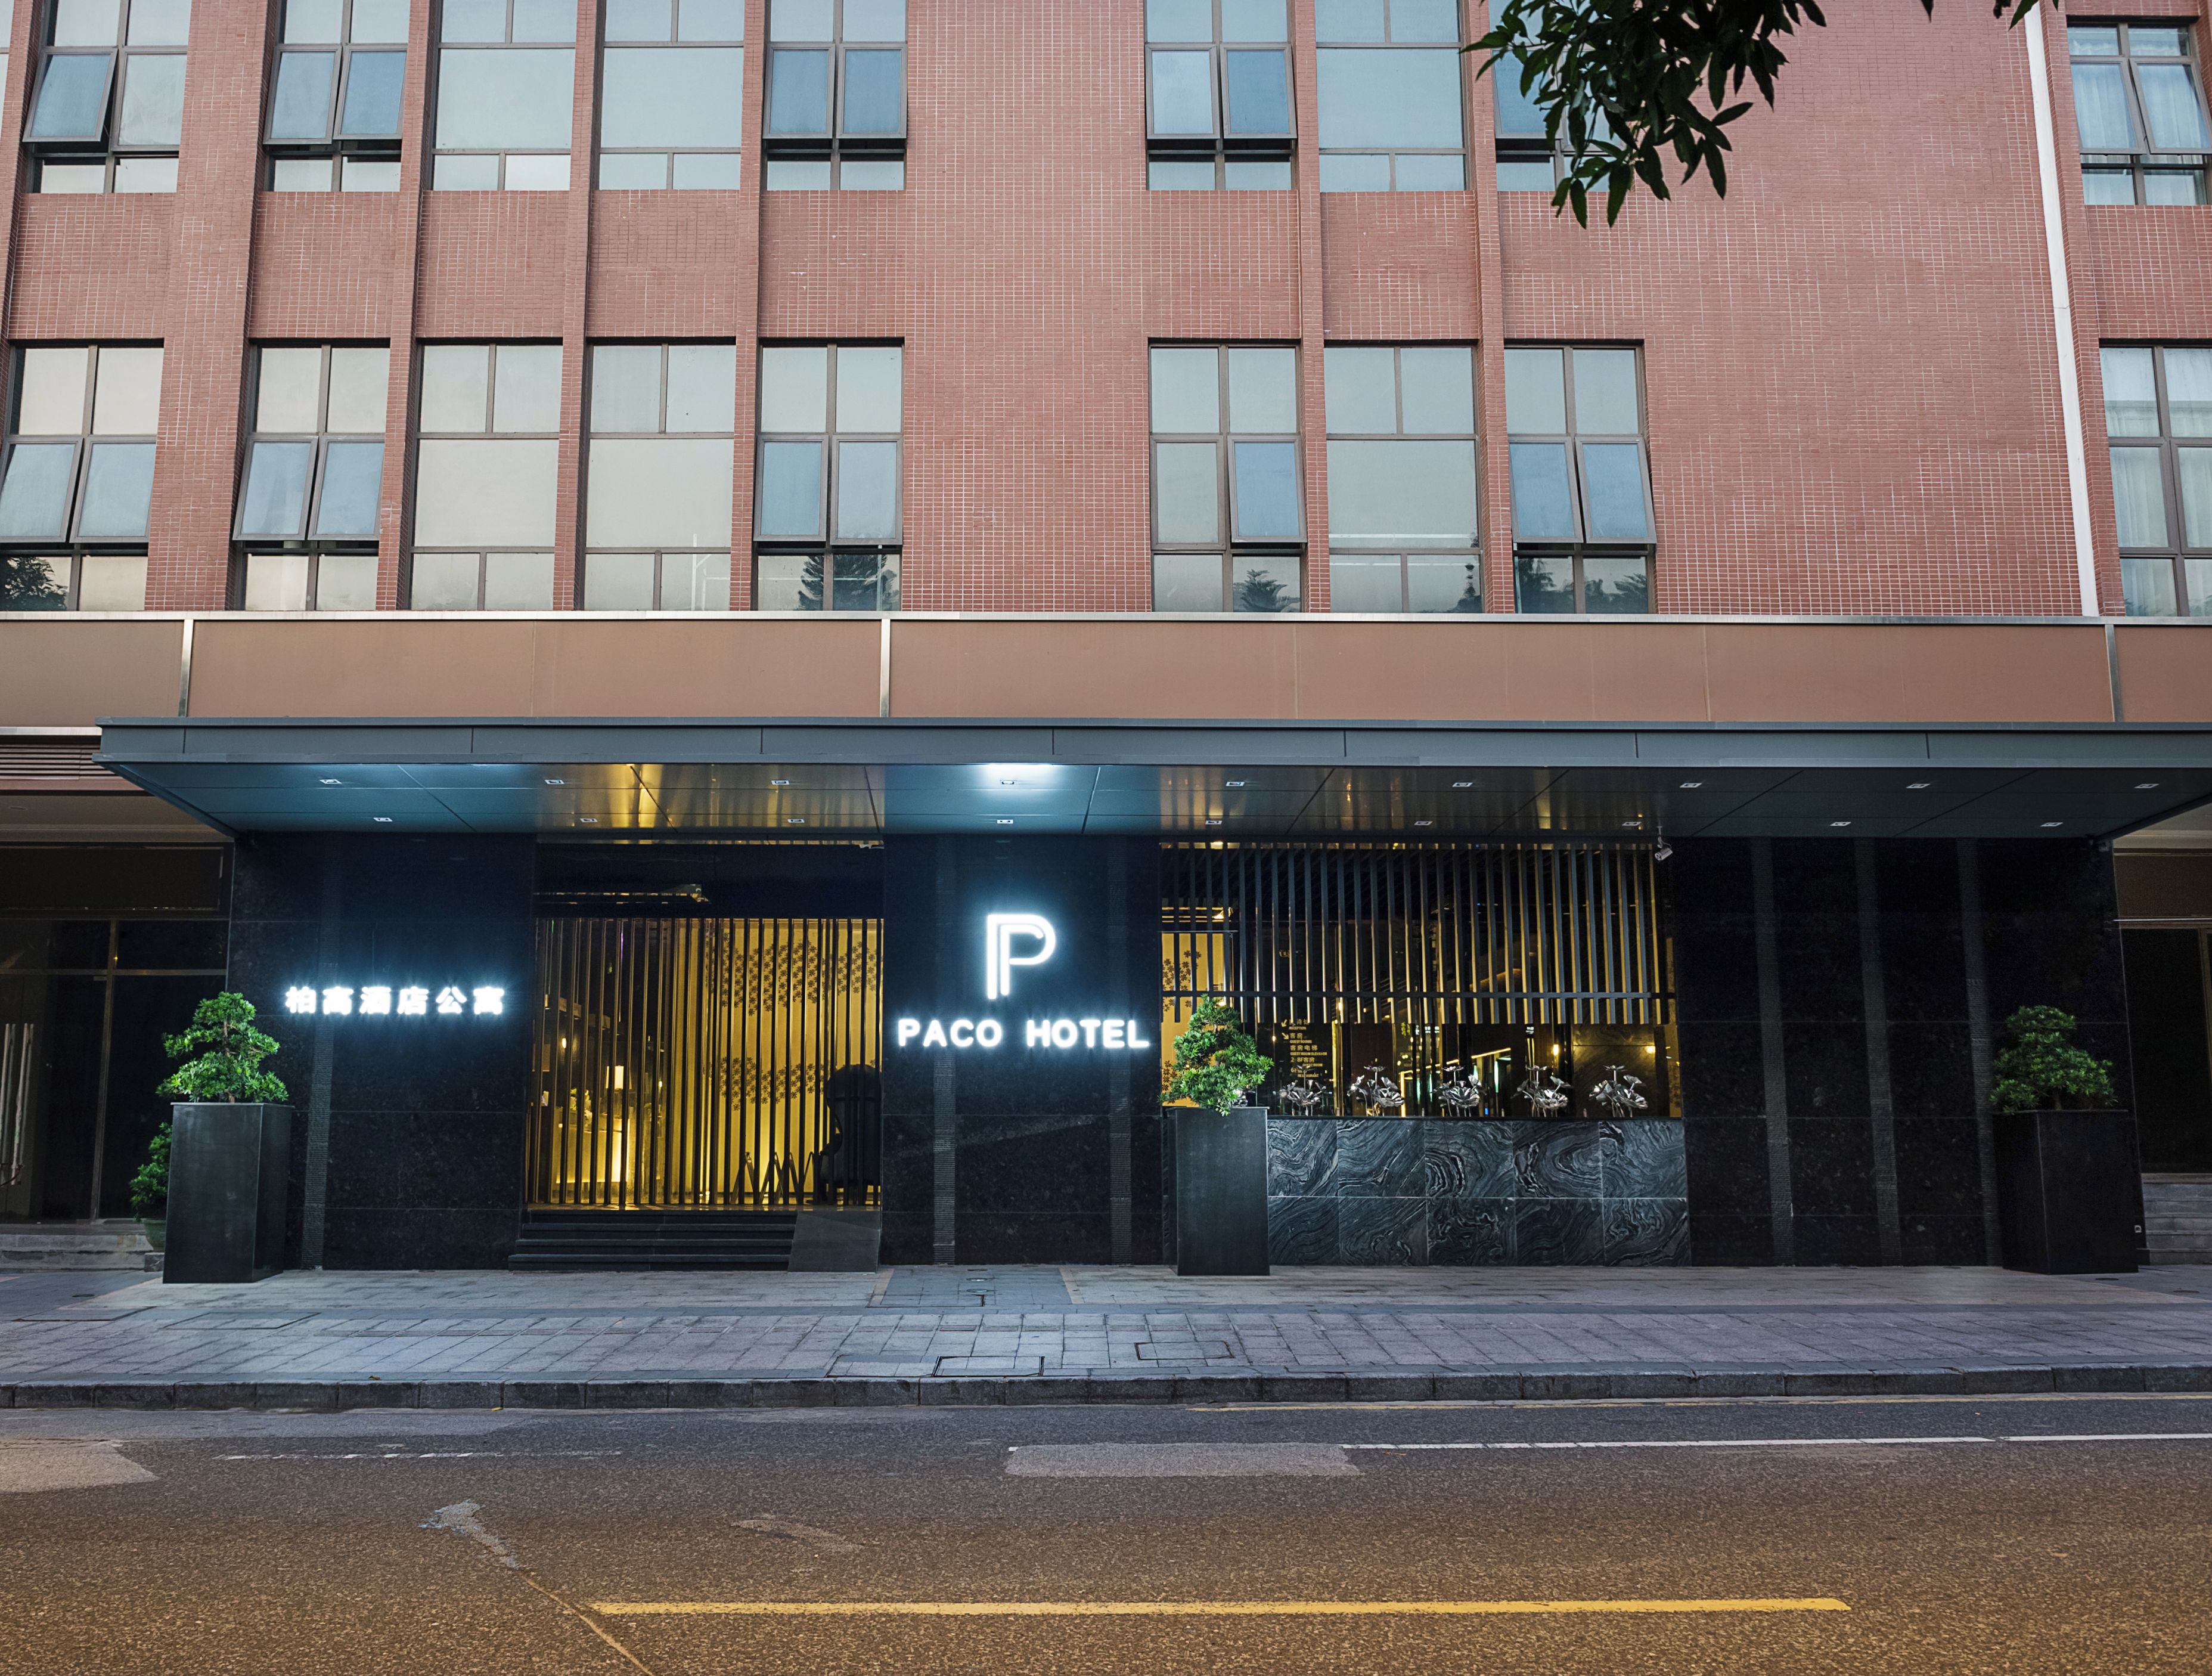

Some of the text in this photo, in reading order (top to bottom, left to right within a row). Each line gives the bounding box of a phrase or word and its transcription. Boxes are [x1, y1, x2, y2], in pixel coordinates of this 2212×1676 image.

[986, 914, 1056, 999] P
[285, 986, 504, 1015] 柏高酒店公寓
[898, 1018, 1149, 1048] PACO HOTEL
